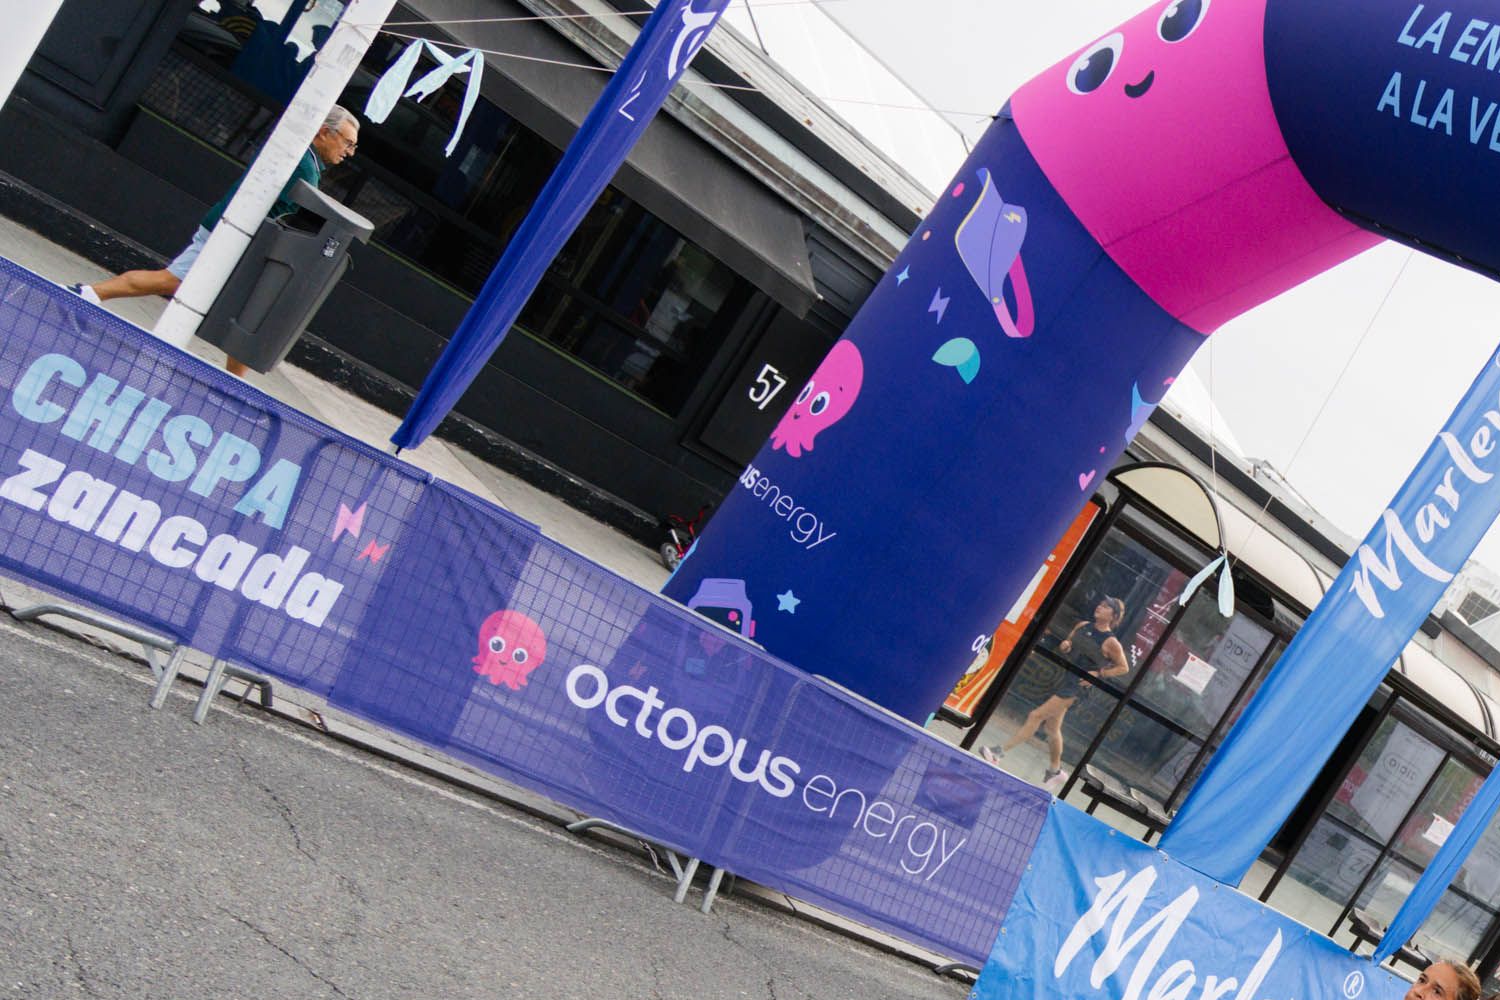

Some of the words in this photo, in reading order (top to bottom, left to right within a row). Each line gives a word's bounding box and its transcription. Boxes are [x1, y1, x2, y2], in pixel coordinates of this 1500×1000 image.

[1397, 4, 1452, 54] LA
[1376, 71, 1402, 118] A
[1410, 80, 1455, 136] LA
[749, 363, 787, 411] 57
[12, 353, 302, 530] CHISPA
[0, 448, 344, 628] zancada
[753, 477, 837, 550] energy
[566, 664, 803, 797] octopus
[802, 774, 966, 881] energy
